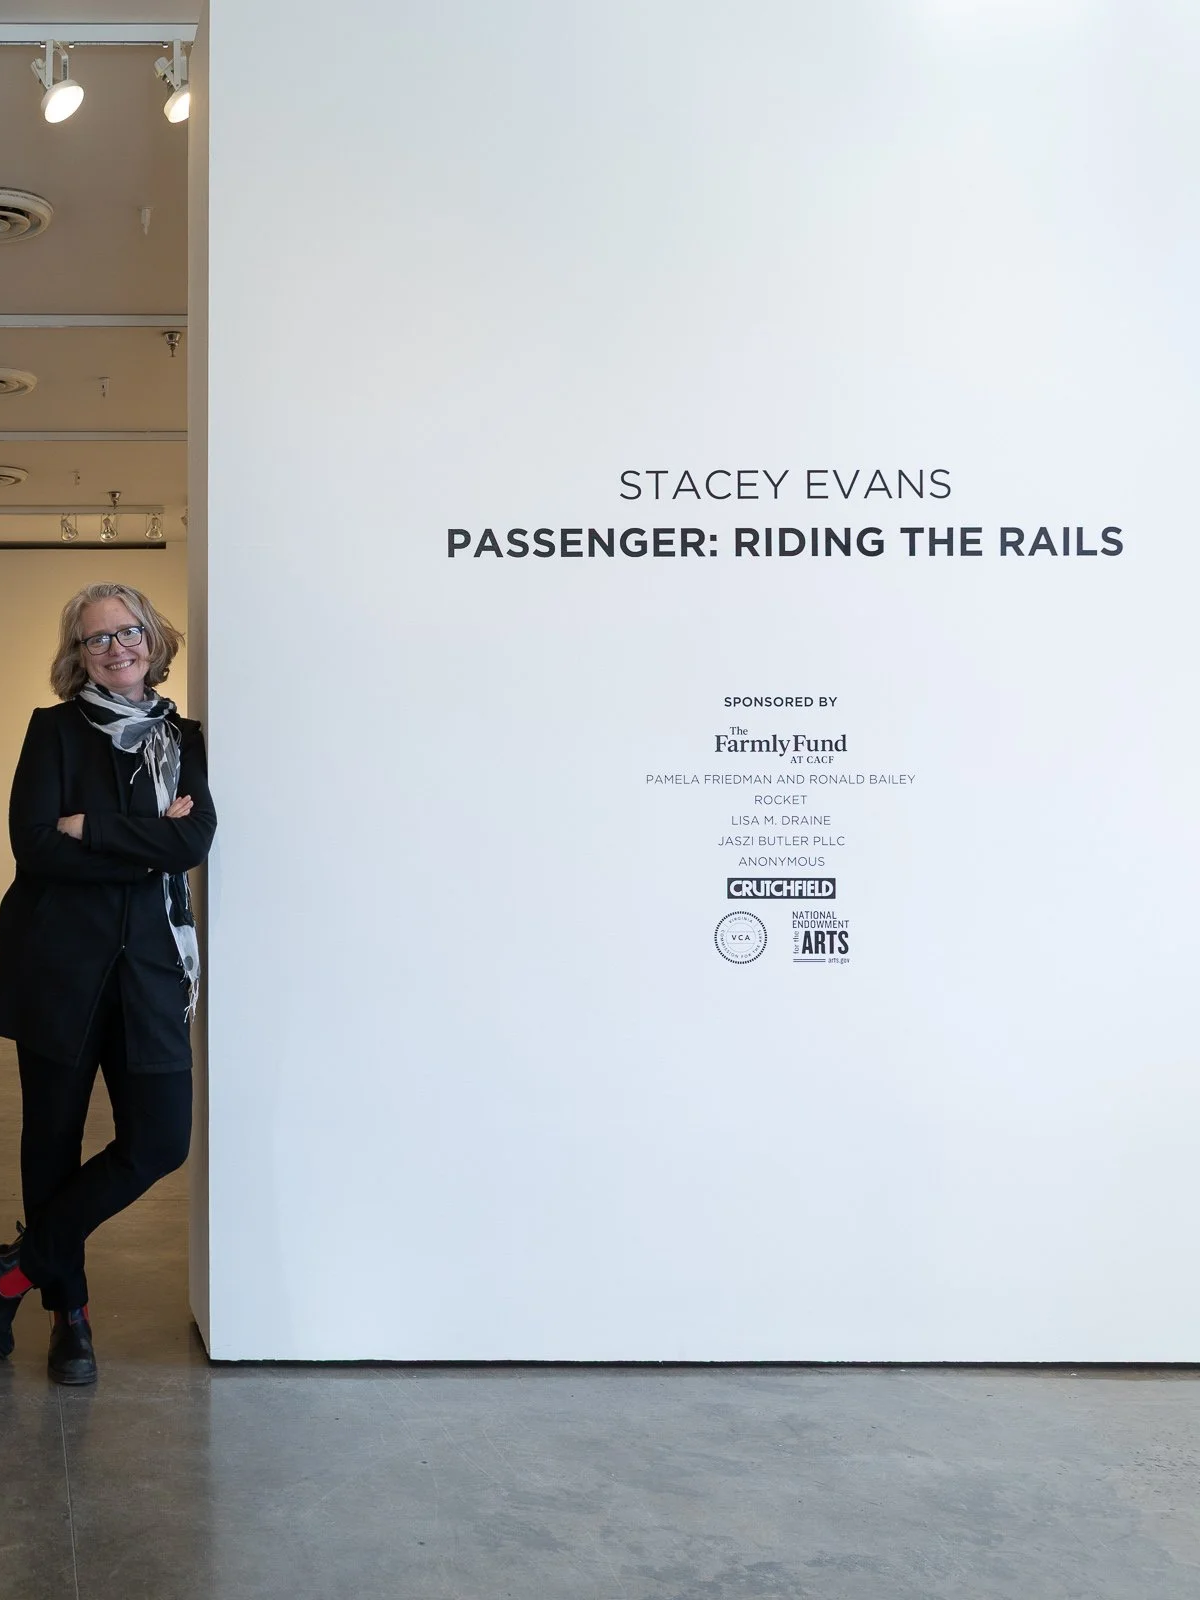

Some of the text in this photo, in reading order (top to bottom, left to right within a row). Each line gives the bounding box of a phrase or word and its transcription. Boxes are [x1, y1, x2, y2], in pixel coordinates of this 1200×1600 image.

[619, 468, 952, 501] STACEY EVANS
[447, 526, 1124, 559] PASSENGER: RIDING THE RAILS
[723, 696, 838, 708] SPONSORED BY
[729, 726, 749, 736] The
[714, 734, 848, 757] Farmly Fund
[790, 755, 835, 764] AT CACF
[645, 774, 916, 785] PAMELA FRIEDMAN AND RONALD BAILEY
[754, 794, 808, 806] ROCKET
[731, 815, 832, 826] LISA M. DRAINE
[717, 835, 846, 847] JASZI BUTLER PLLC
[738, 856, 826, 867] ANONYMOUS
[729, 880, 834, 897] CRUTCHFIELD
[792, 910, 837, 920] NATIONAL
[792, 919, 850, 929] ENDOWMENT
[801, 930, 849, 955] ARTS
[828, 957, 850, 965] arts.gov
